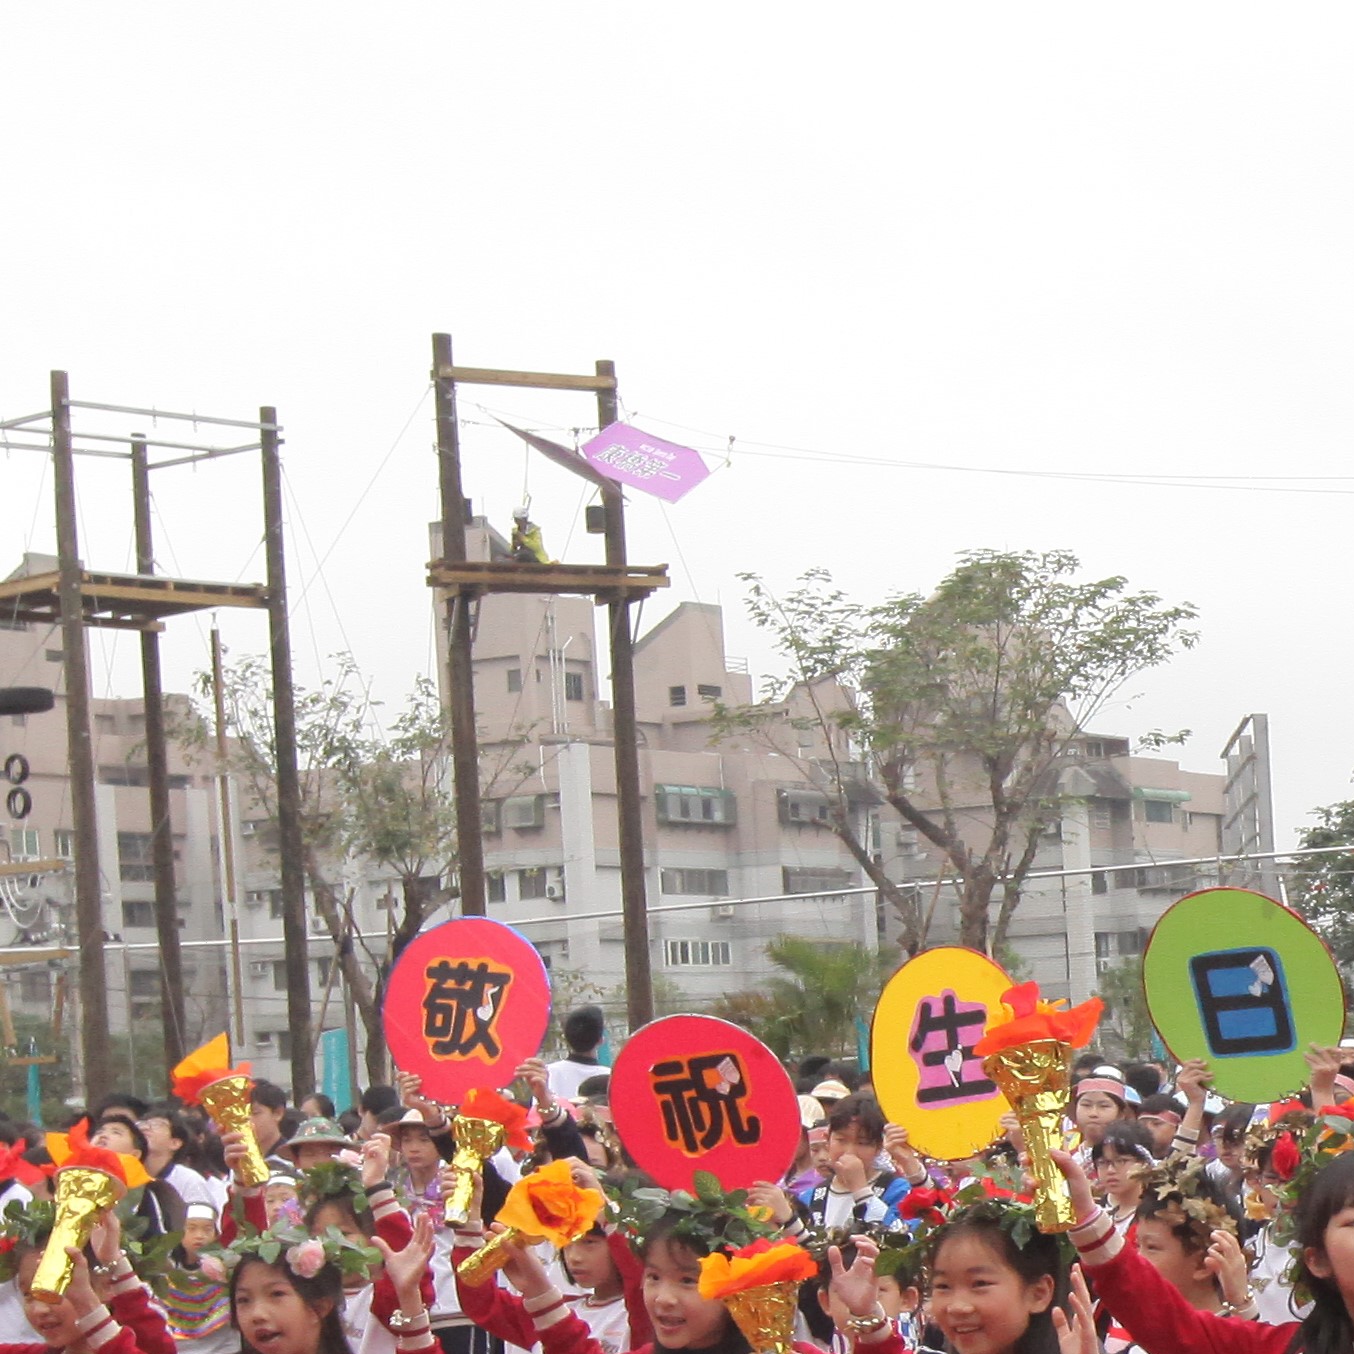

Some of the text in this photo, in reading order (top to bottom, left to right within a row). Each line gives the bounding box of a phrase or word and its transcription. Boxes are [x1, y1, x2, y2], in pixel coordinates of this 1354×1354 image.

[424, 960, 511, 1057] 敬
[911, 990, 1000, 1106] 生
[1189, 947, 1296, 1056] 日
[651, 1053, 762, 1151] 祝
